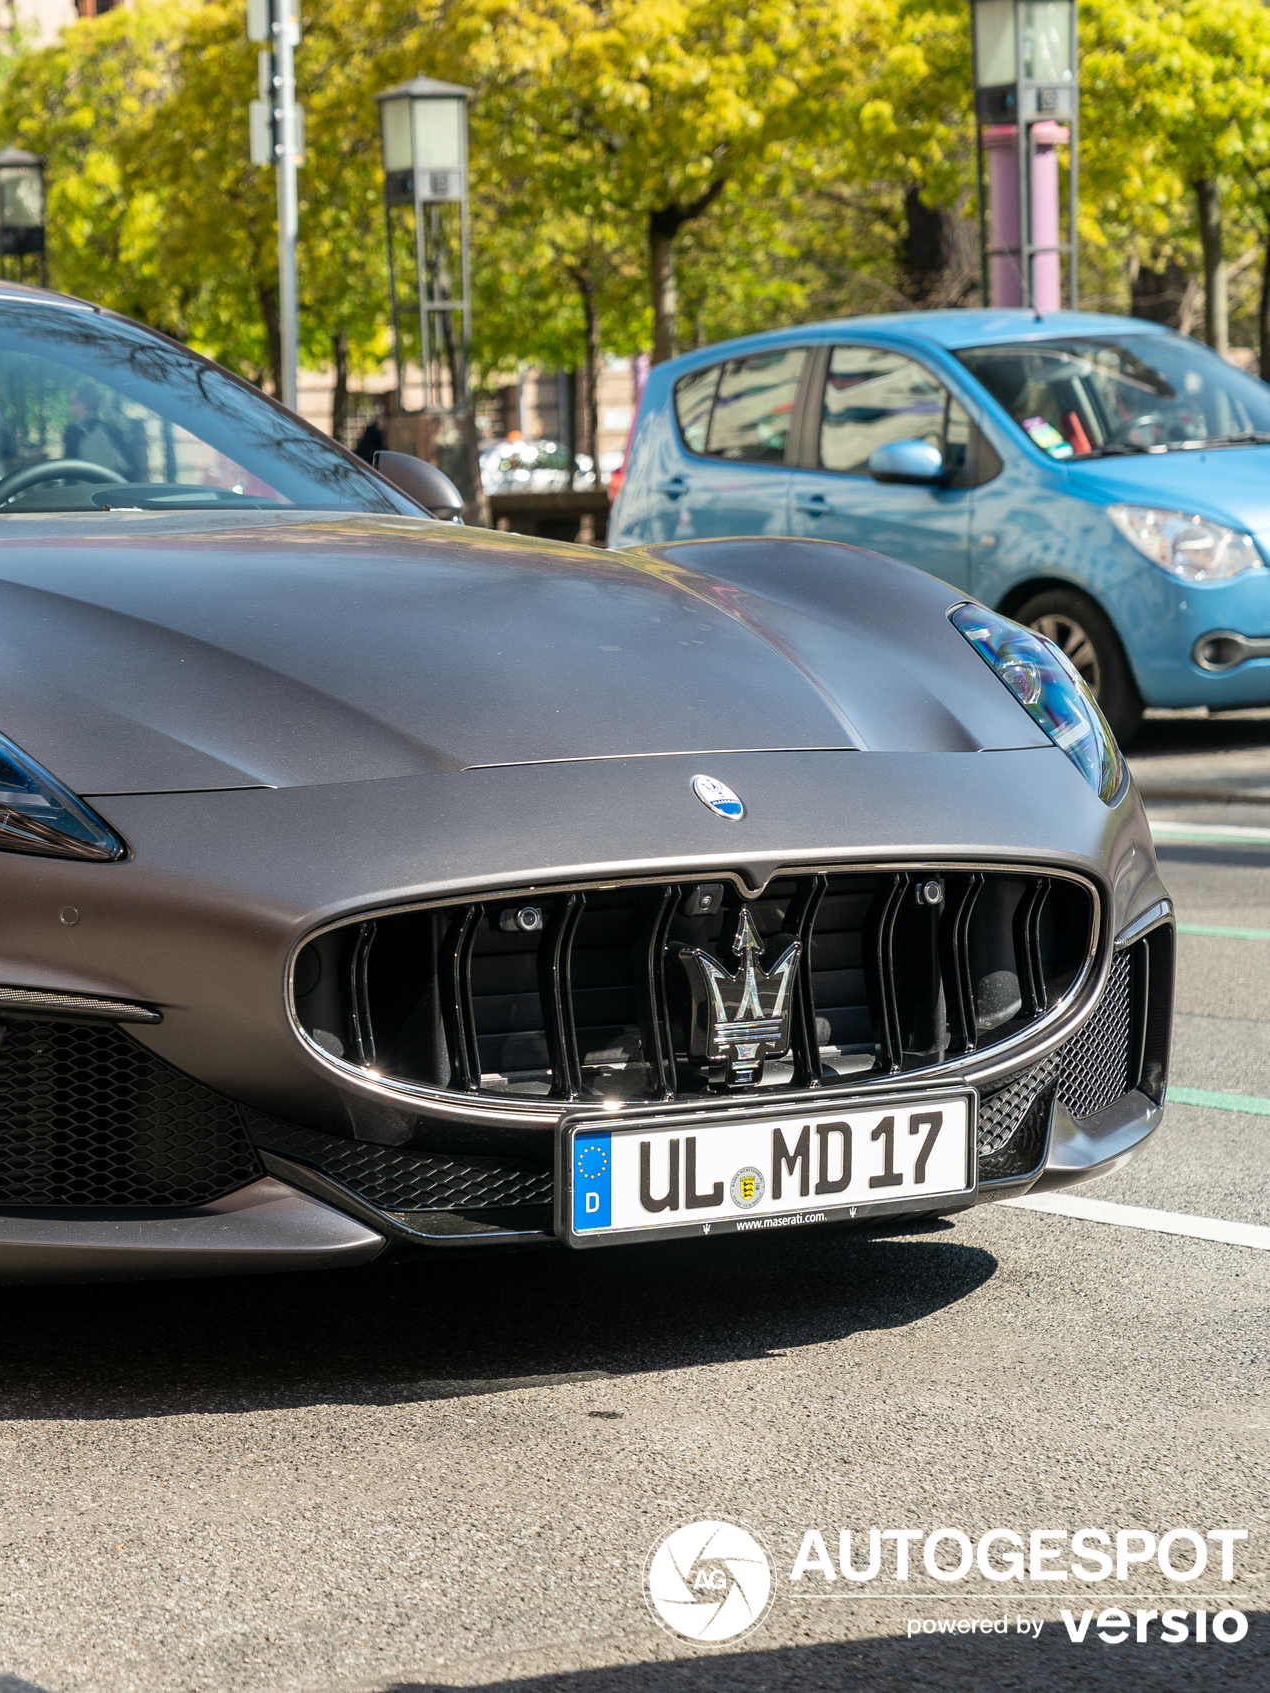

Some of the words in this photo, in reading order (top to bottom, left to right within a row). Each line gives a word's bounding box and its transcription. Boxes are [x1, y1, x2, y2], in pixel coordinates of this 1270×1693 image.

[640, 1136, 724, 1213] UL
[772, 1121, 853, 1200] MD
[869, 1111, 943, 1189] 17
[585, 1192, 600, 1213] D
[736, 1212, 825, 1231] www.maserati.com
